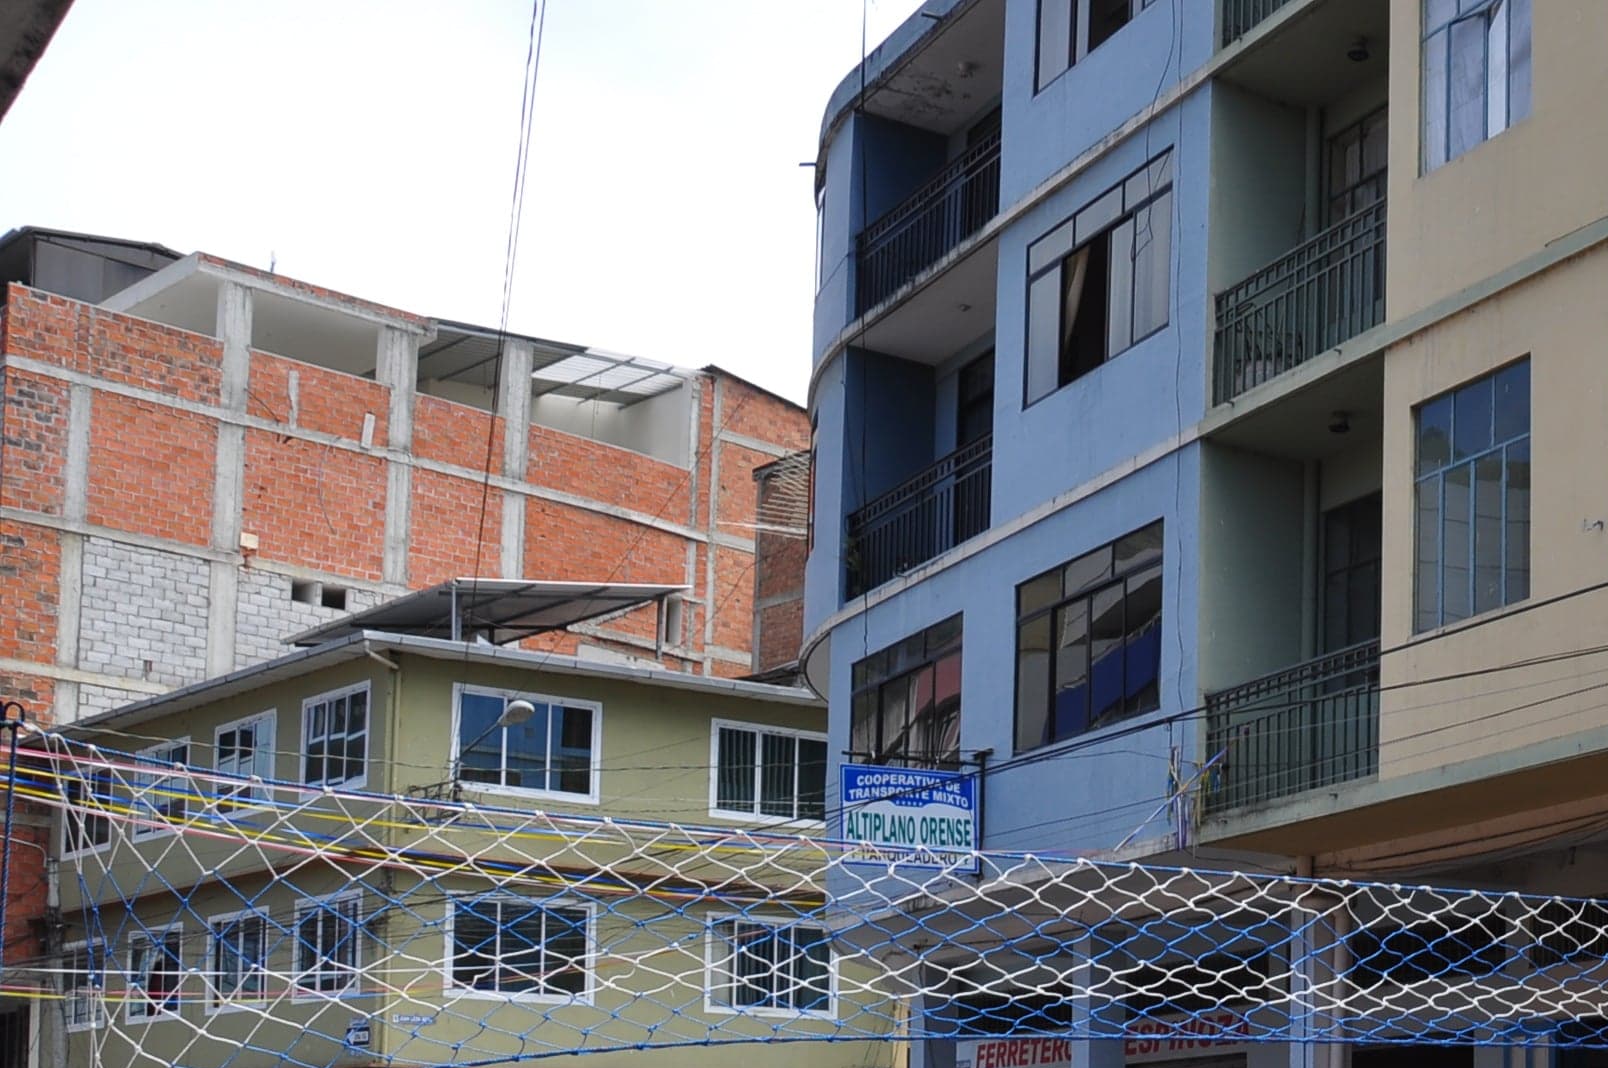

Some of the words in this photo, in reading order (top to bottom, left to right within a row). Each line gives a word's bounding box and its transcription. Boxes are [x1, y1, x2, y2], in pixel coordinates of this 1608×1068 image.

[849, 787, 930, 801] TRANSPORTE
[932, 791, 969, 807] MIXTO
[856, 774, 942, 789] COOPERATIVA
[945, 781, 961, 793] DE
[846, 811, 916, 844] ALTIPLANO
[919, 816, 972, 847] ORENSE
[1125, 1014, 1249, 1056] ESPINOZA
